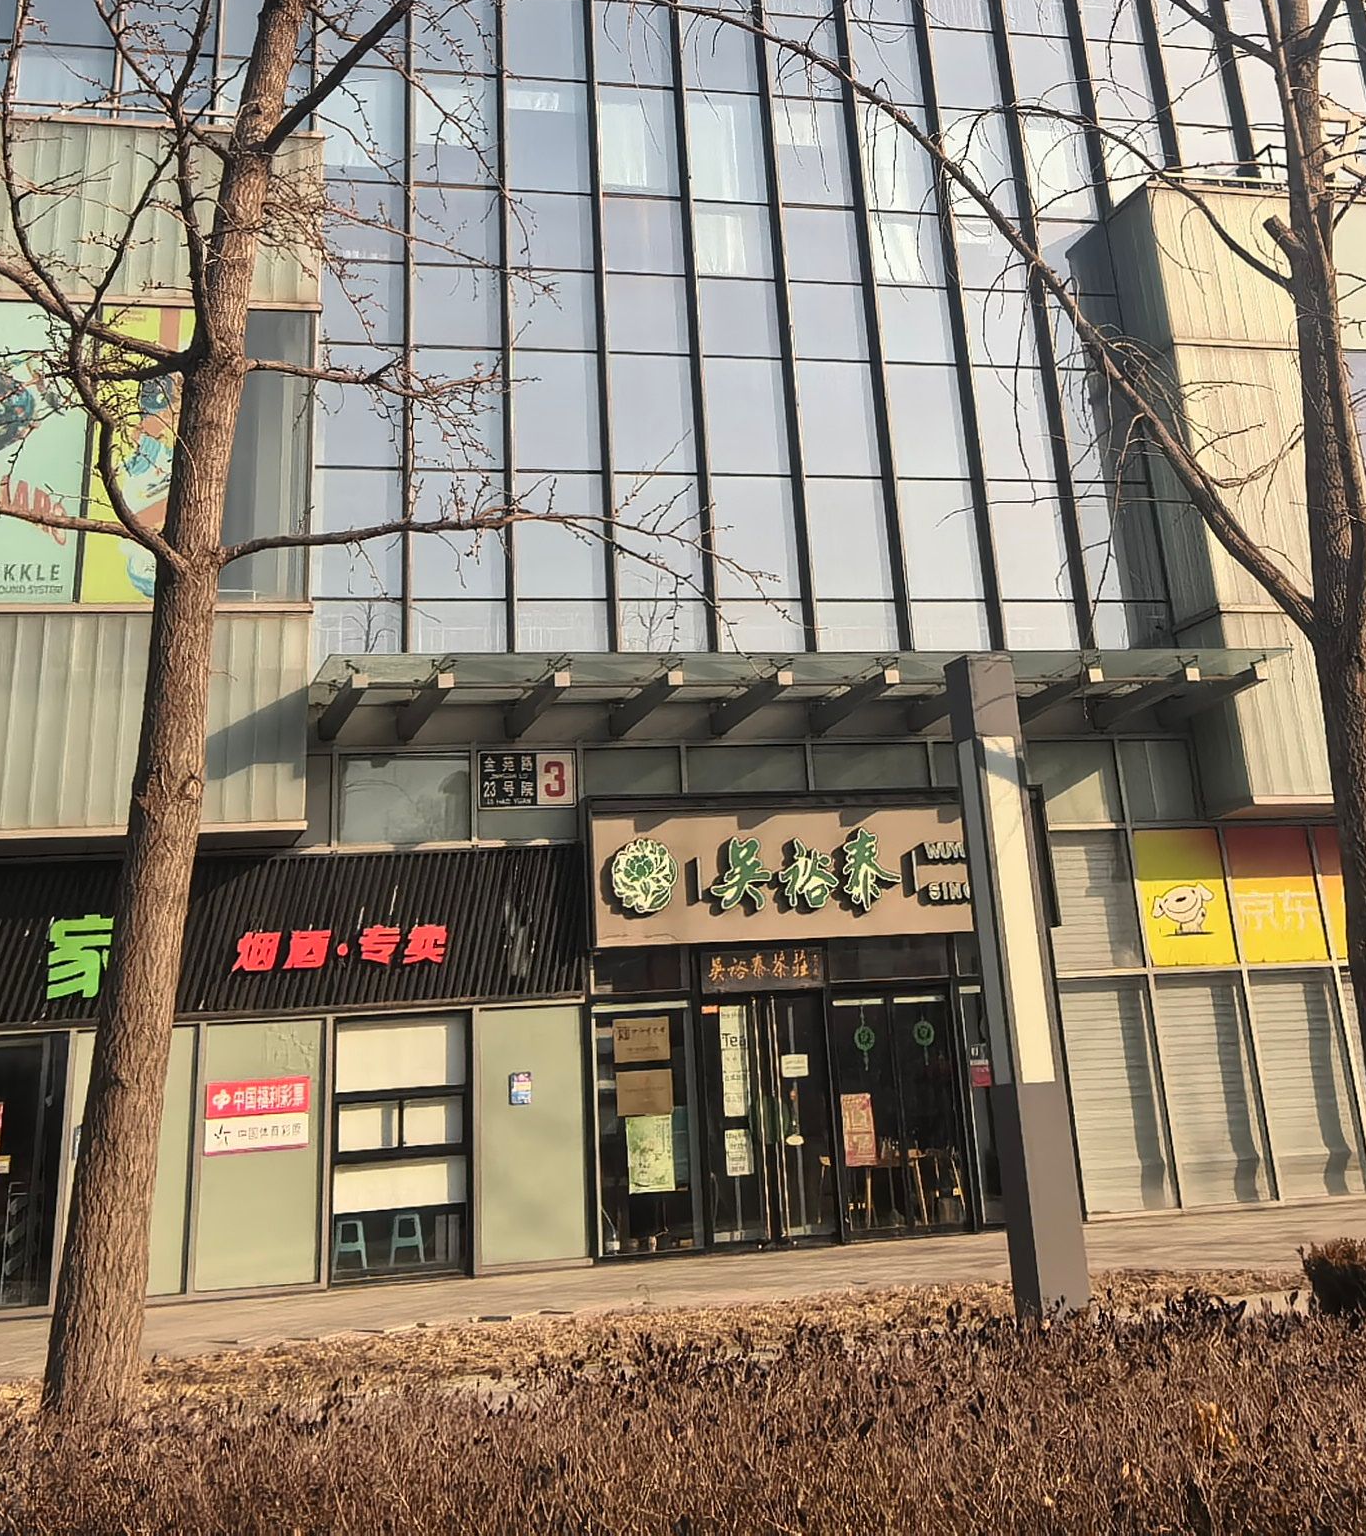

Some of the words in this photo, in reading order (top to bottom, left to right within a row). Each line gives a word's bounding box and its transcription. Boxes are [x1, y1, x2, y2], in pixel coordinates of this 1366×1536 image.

[482, 780, 535, 798] 23号院
[543, 760, 566, 798] 3
[233, 1082, 307, 1112] 中国福利彩票
